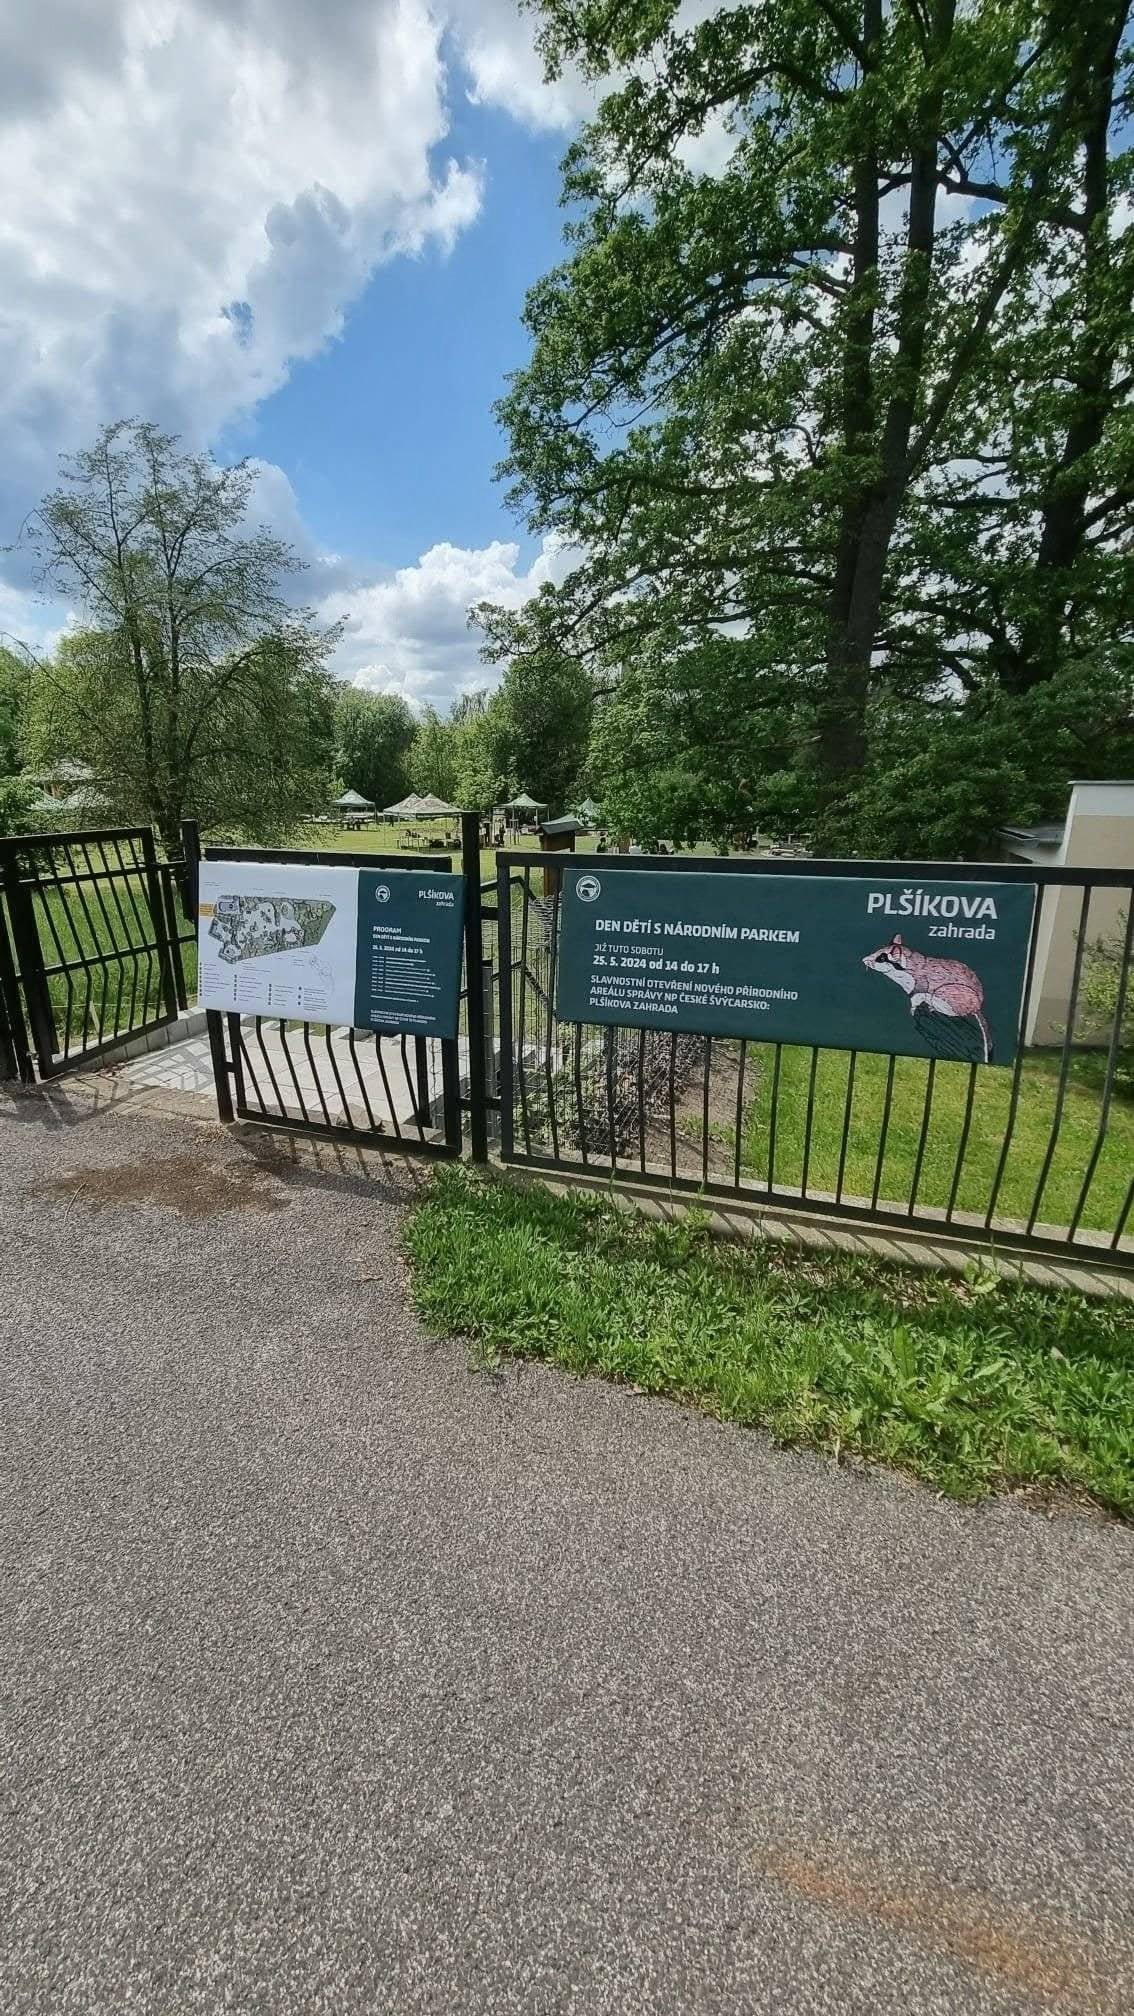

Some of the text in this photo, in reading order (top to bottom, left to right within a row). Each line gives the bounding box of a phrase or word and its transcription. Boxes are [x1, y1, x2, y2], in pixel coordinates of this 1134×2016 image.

[418, 889, 454, 900] PLŠÍKOVA
[867, 889, 998, 919] PLŠÍKOVA
[595, 918, 800, 942] DEN DĚTÍ S NÁRODNÍM PARKEM
[928, 922, 995, 940] zahrada
[594, 942, 663, 956] JIŽ TUTO SOBOTU
[593, 956, 720, 974] 25. 5. 2024 od 14 do 17 h
[591, 975, 798, 1000] SLAVNOSTNÍ OTEVŘENÍ NOVÉHO PŘÍRODNÍHO
[590, 986, 770, 1009] AREÁLU SPRÁVY NP ČESKÉ ŠVÝCARSKO:
[590, 997, 678, 1013] PLŠÍKOVA ZAHRADA
